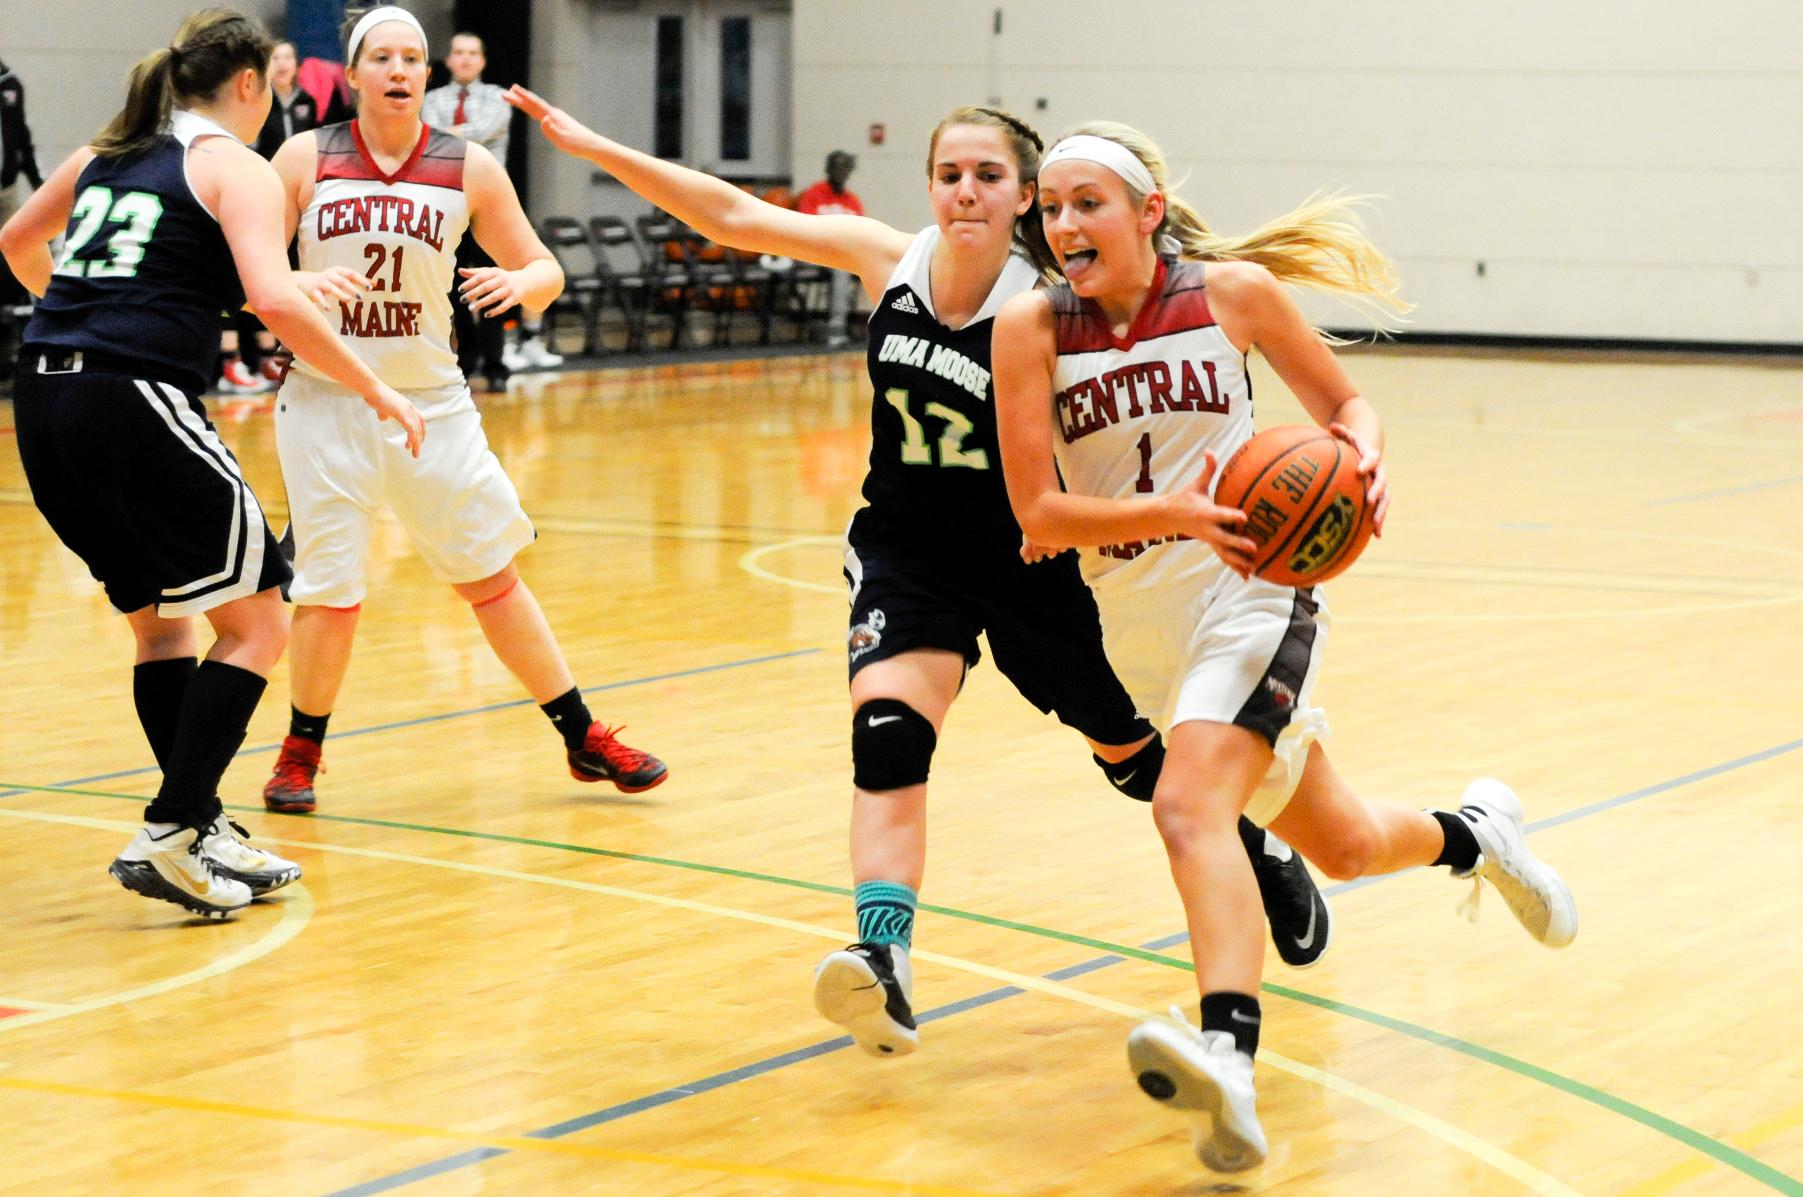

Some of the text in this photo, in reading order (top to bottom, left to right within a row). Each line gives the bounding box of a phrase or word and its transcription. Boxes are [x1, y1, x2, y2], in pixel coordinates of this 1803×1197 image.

[52, 185, 164, 277] 23
[317, 195, 444, 253] CENTRAL
[363, 243, 404, 292] 21
[891, 302, 918, 314] adidas
[878, 334, 991, 402] UMA MOOSE
[885, 387, 990, 470] 12
[1055, 360, 1230, 444] CENTRAL
[1135, 432, 1154, 493] 1
[1272, 457, 1320, 504] THE
